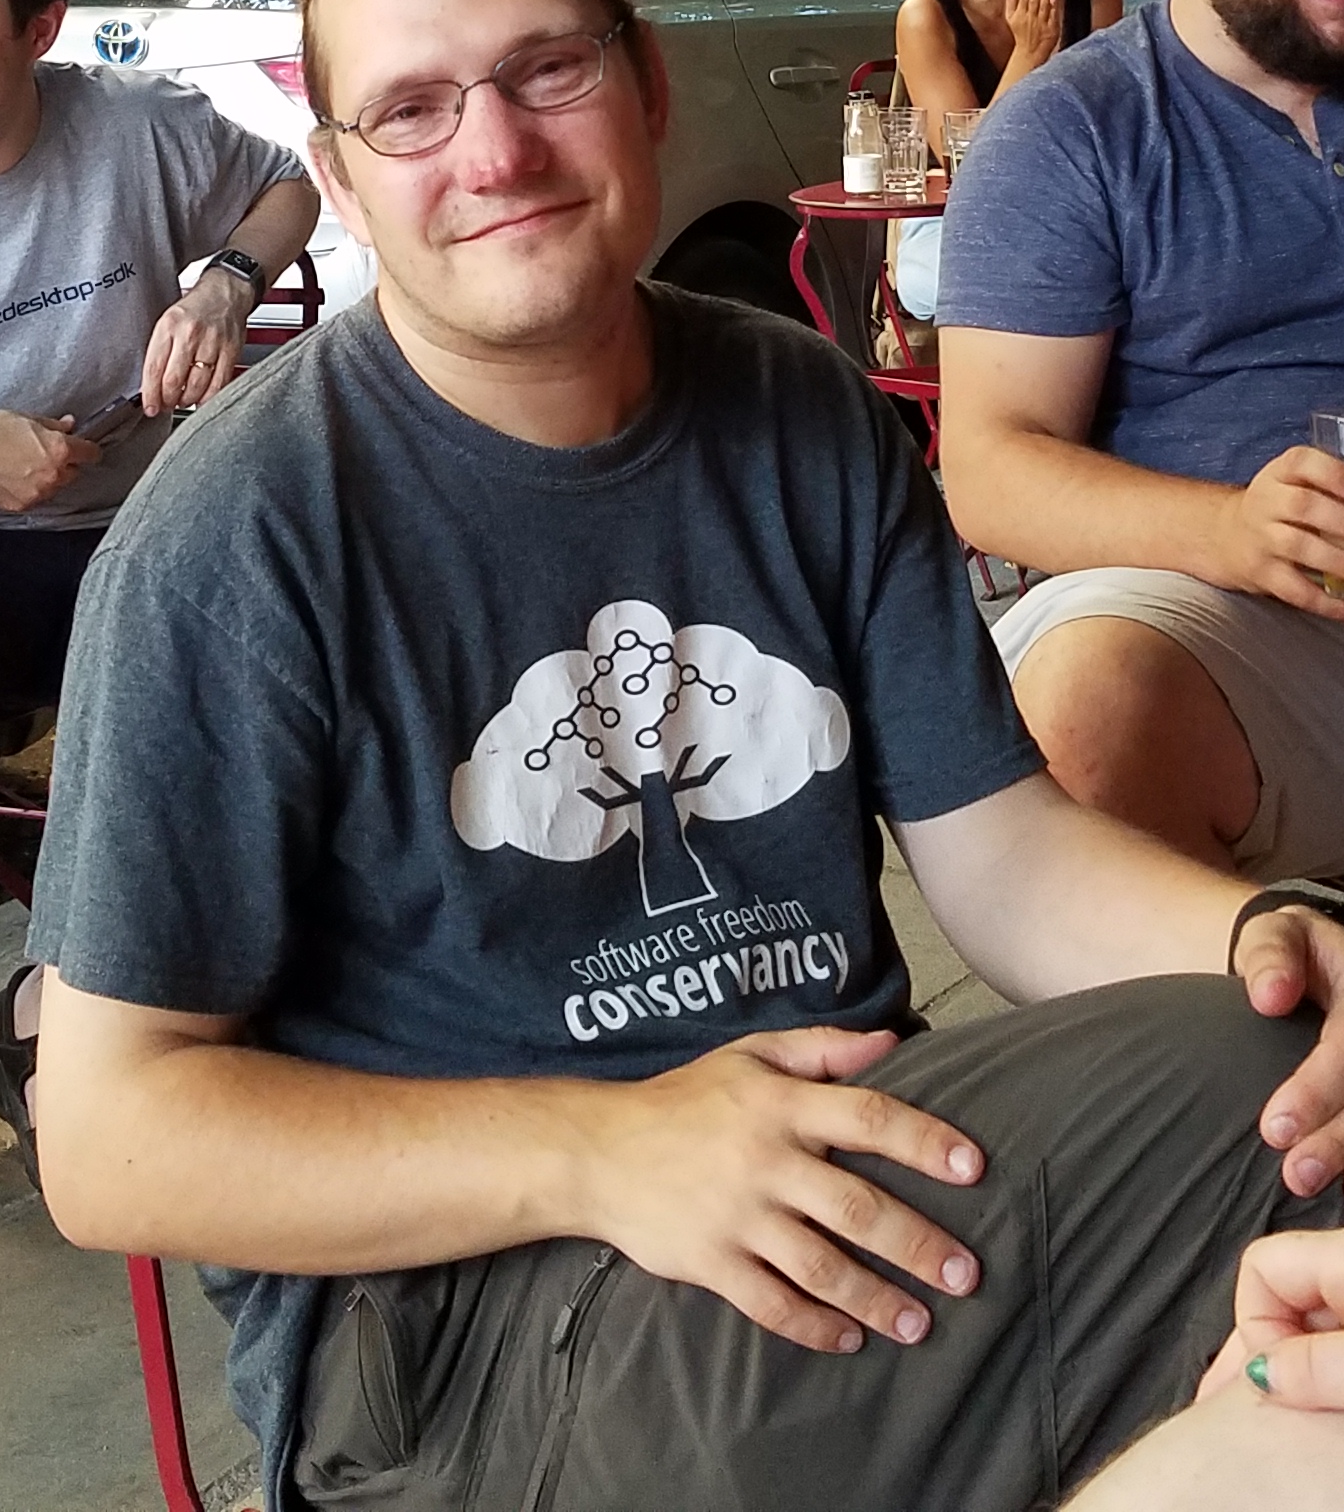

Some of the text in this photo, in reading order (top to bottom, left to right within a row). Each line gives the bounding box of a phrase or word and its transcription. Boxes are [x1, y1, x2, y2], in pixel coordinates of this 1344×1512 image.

[563, 932, 849, 1042] conservancy
[570, 894, 812, 986] software freedom
